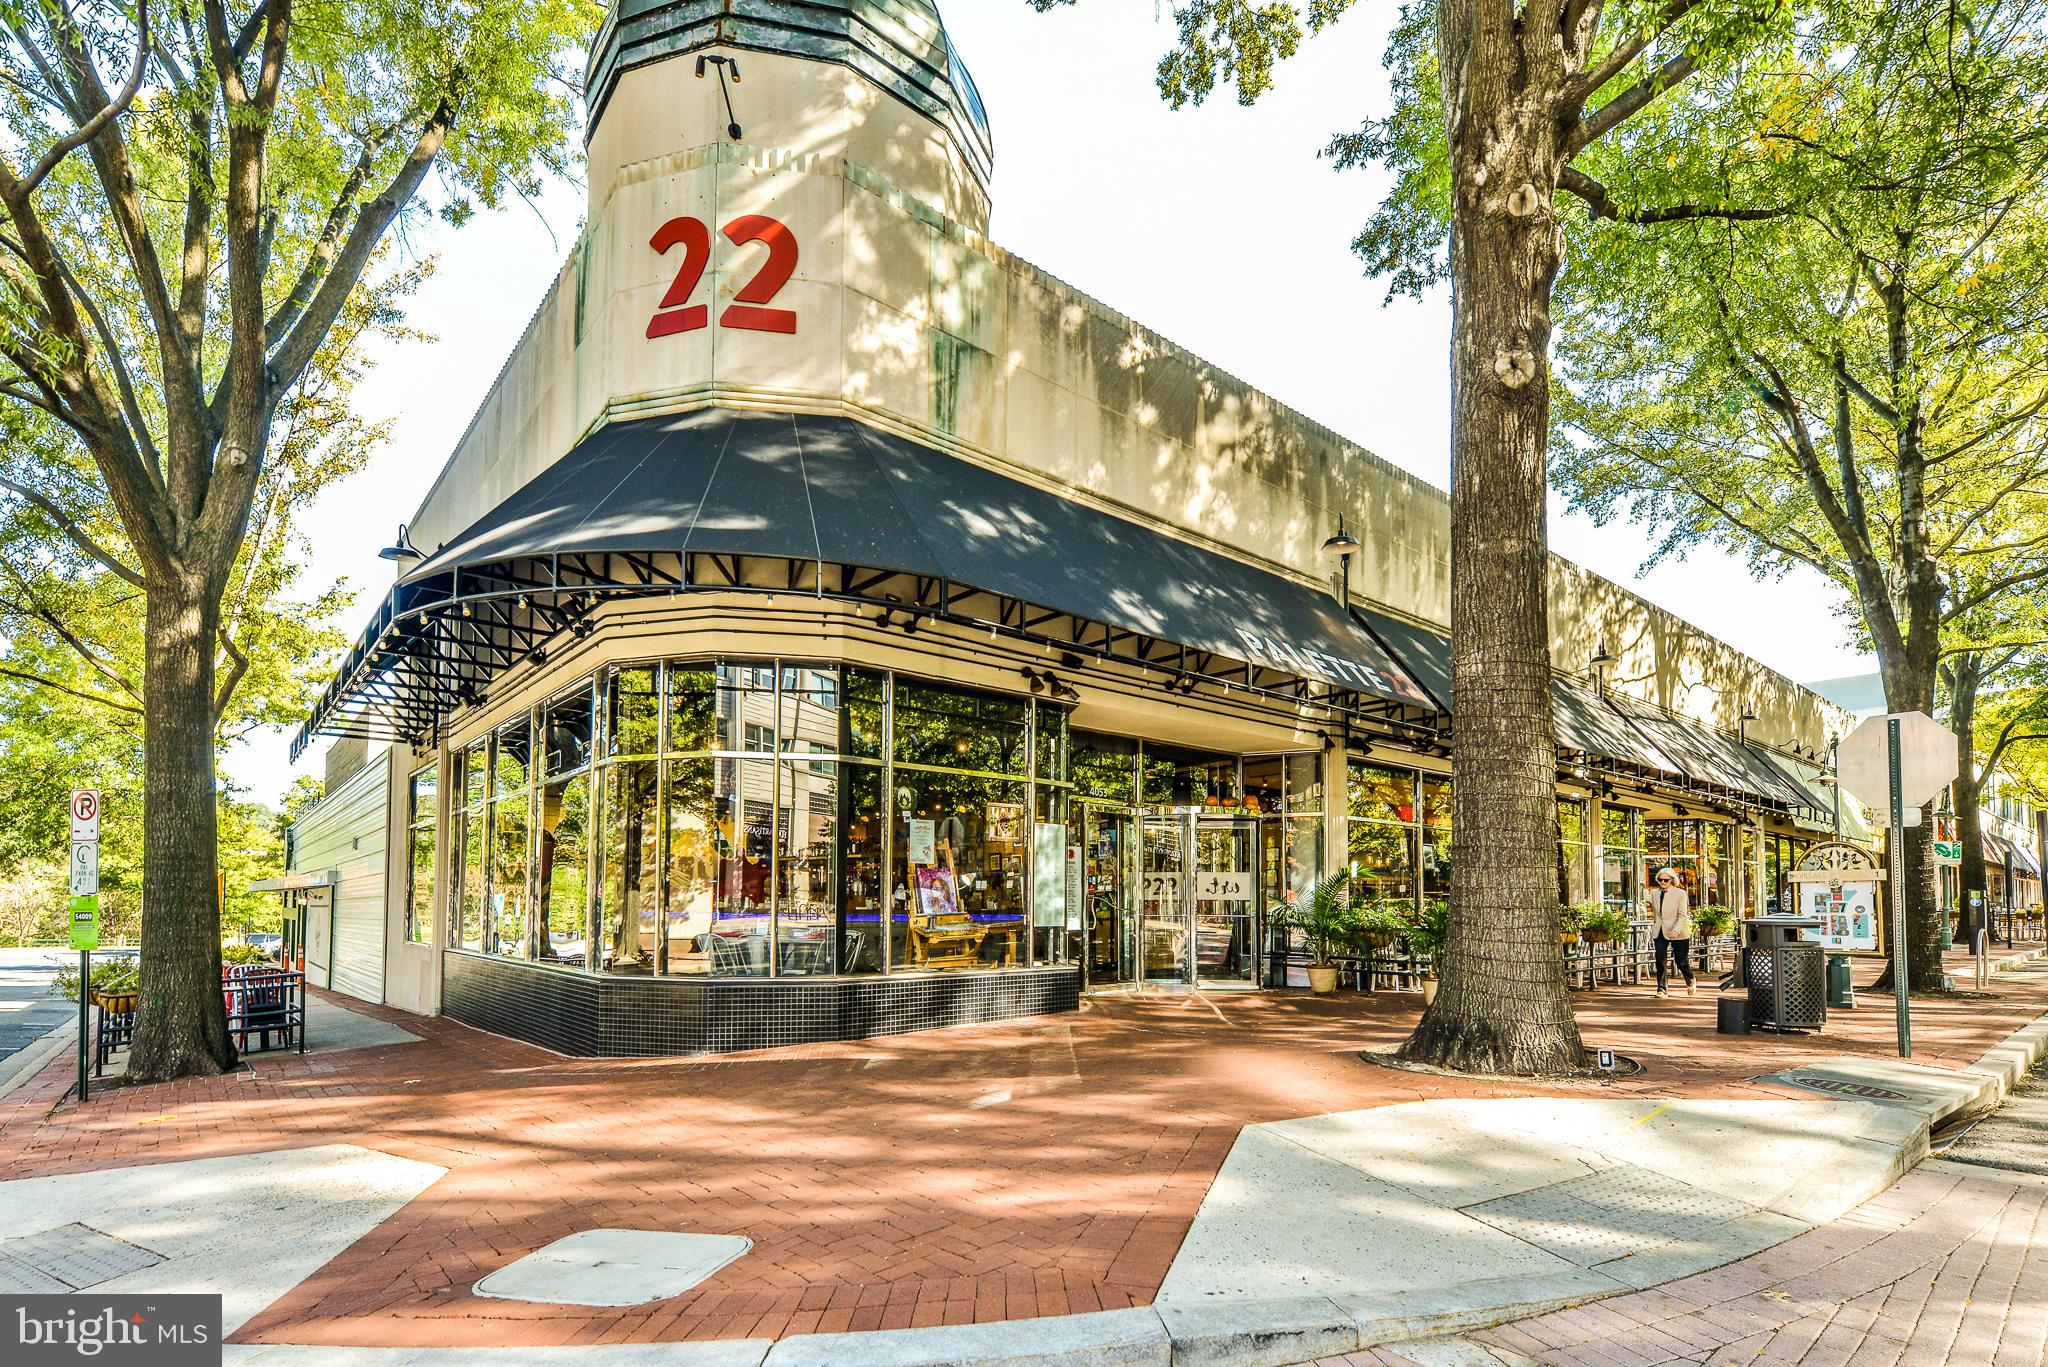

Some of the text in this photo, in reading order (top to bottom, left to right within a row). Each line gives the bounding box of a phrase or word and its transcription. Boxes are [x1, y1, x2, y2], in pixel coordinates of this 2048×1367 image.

[646, 215, 798, 339] 22
[1235, 628, 1392, 692] PALETTE
[1089, 787, 1108, 798] 4053
